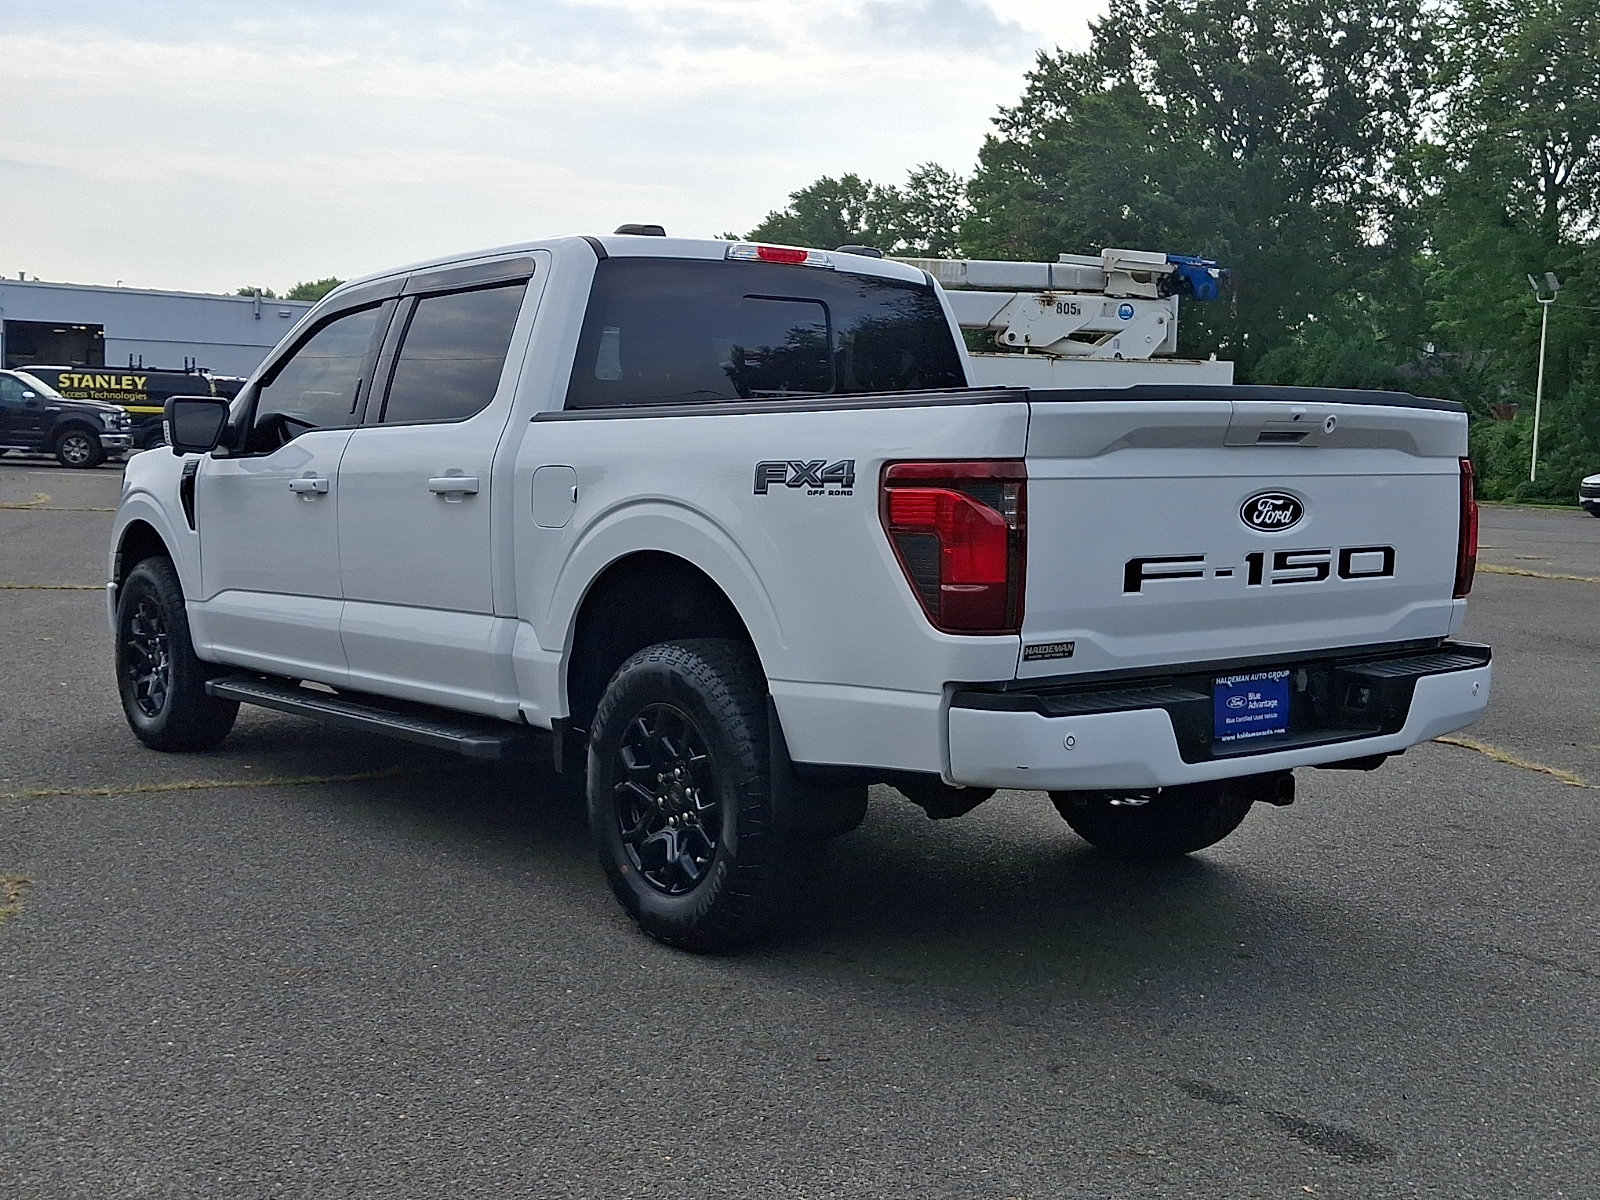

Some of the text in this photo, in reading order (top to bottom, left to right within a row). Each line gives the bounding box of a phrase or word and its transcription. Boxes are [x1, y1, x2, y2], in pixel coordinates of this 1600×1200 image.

[58, 373, 147, 390] STANLEY
[61, 390, 147, 401] Access Technologies
[754, 460, 855, 495] FX4
[807, 489, 853, 497] OFF ROAD
[1253, 498, 1294, 525] Ford
[1122, 545, 1397, 595] F-150
[1025, 643, 1074, 655] HALDEMAN
[1216, 670, 1290, 685] HALDEMAN AUTO GROUP
[1248, 692, 1261, 700] Blue
[1248, 700, 1278, 709] Advantage
